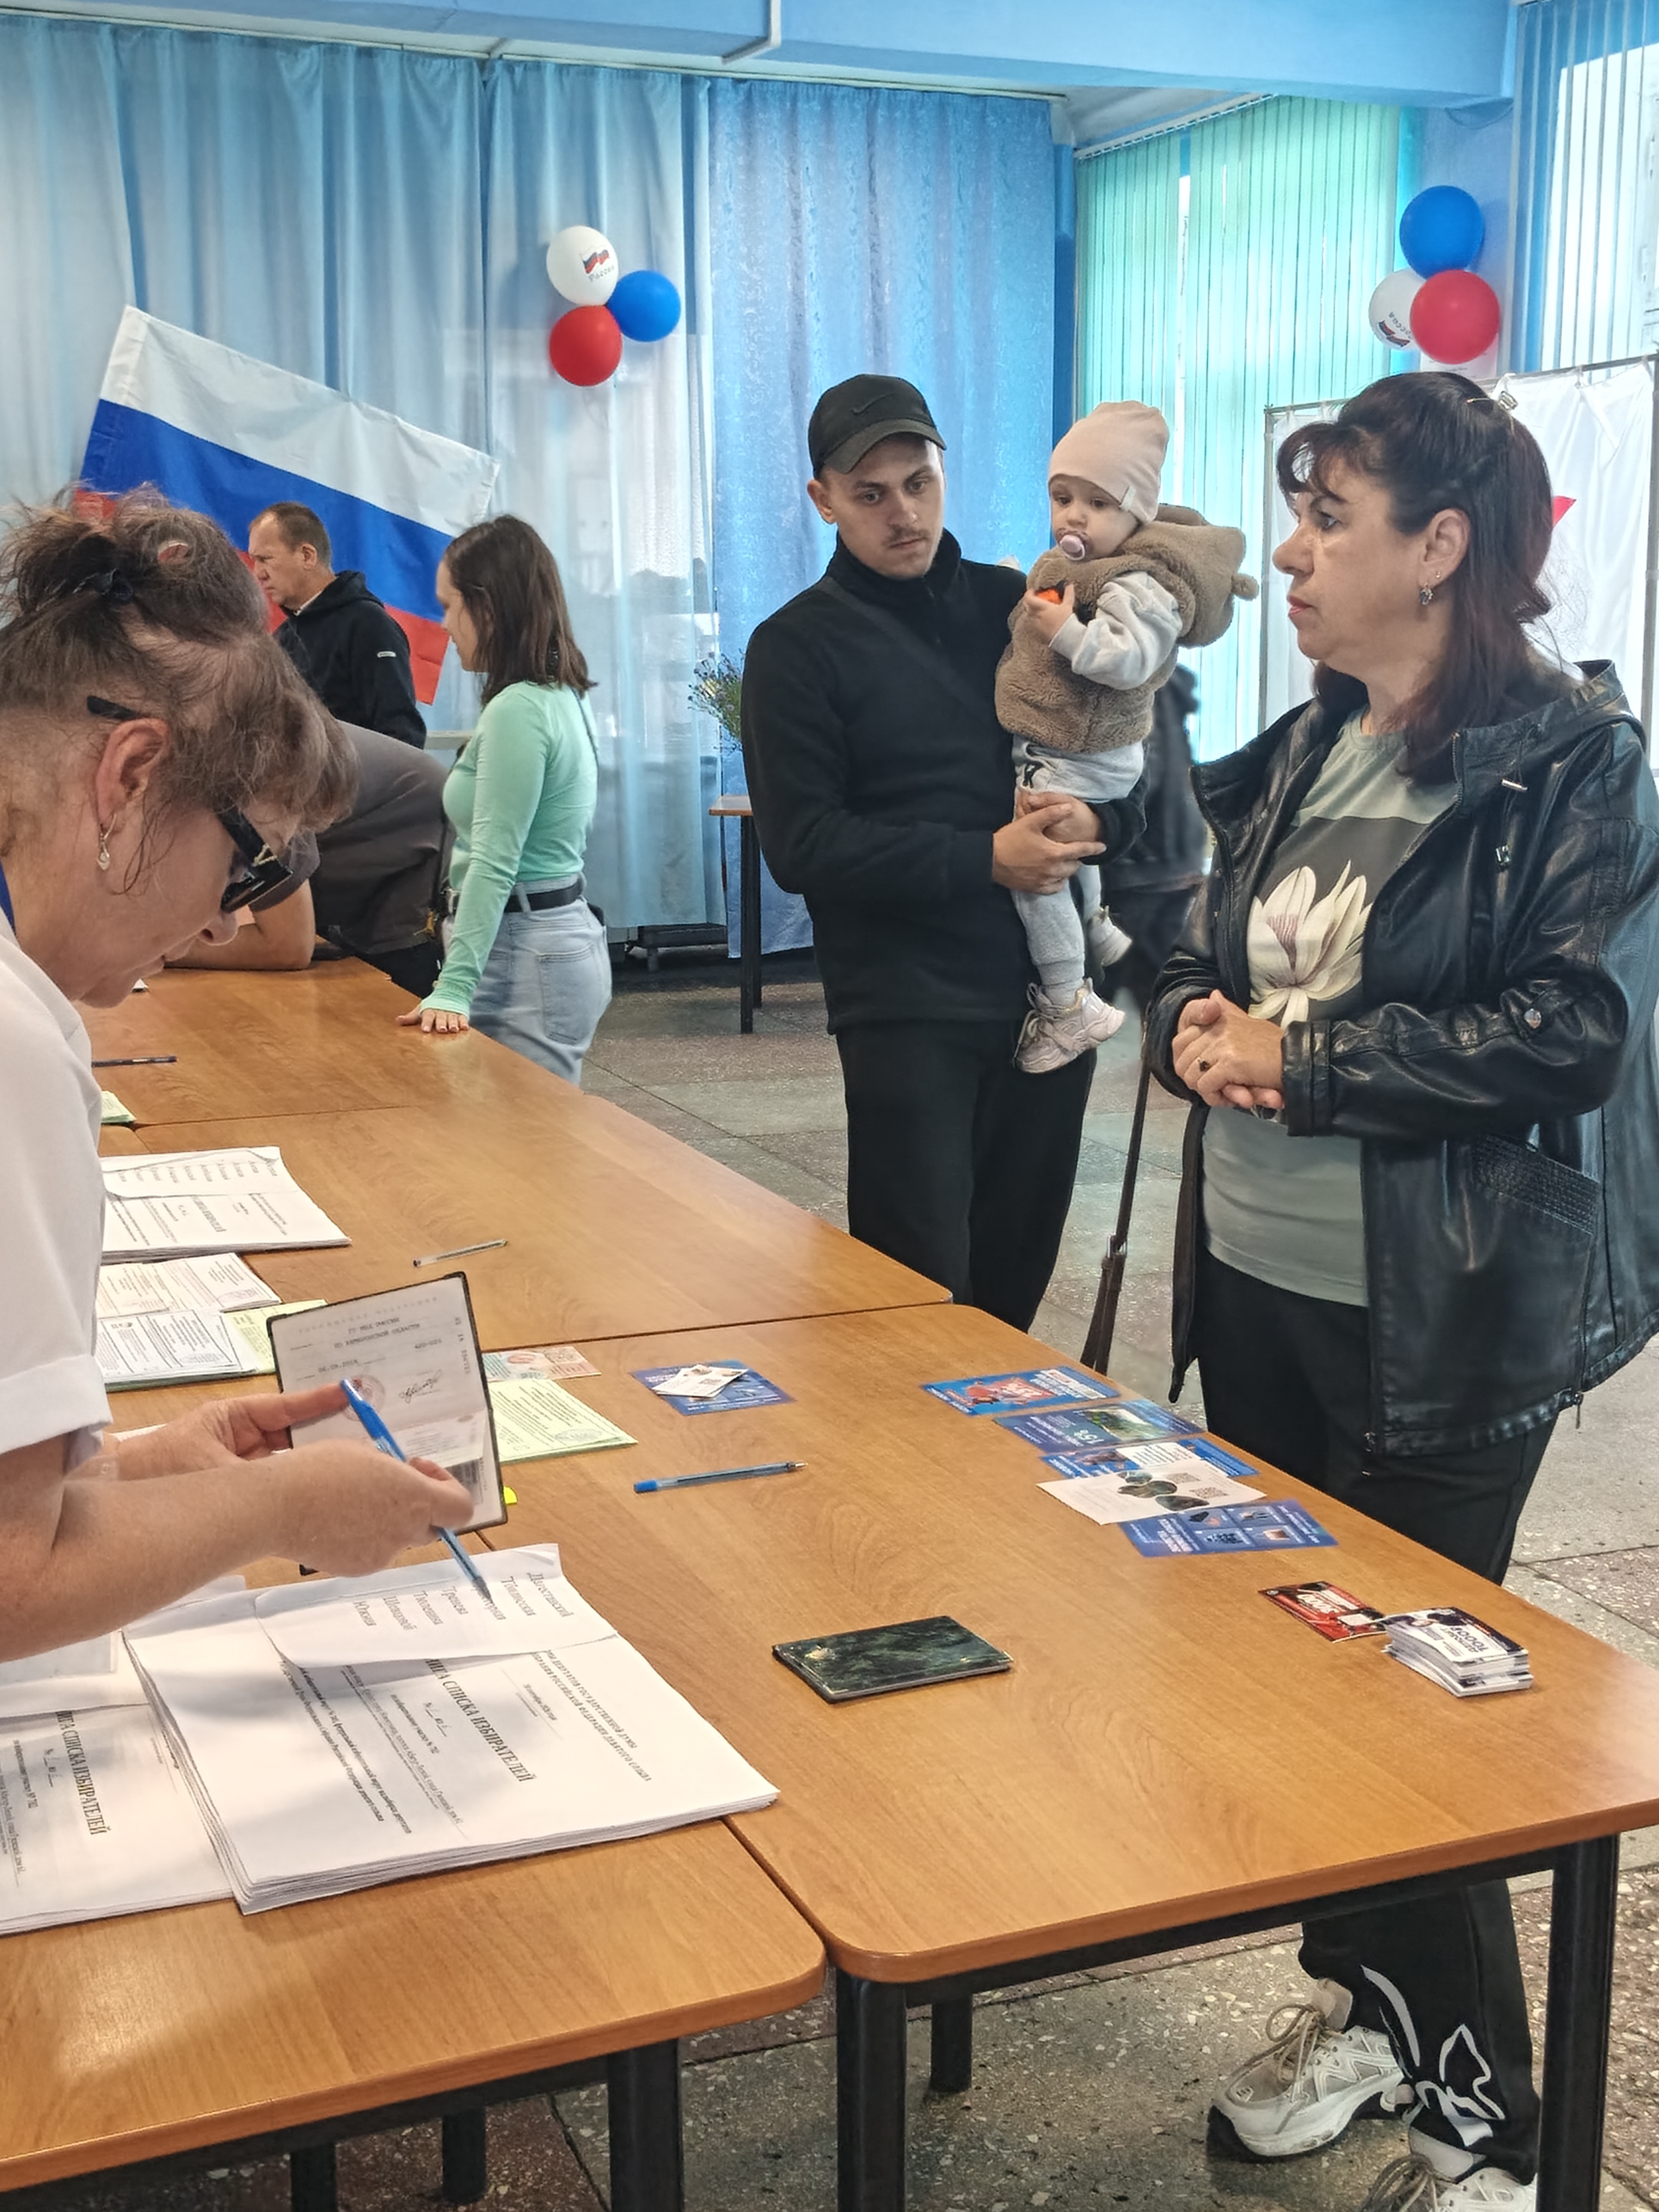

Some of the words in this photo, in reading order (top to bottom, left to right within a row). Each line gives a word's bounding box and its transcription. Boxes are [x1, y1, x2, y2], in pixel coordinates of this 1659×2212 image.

[62, 1730, 86, 1766] СПИСКА
[443, 1680, 480, 1716] СПИСКА
[470, 1716, 537, 1782] ИЗБИРАТЕЛЕЙ
[72, 1767, 112, 1835] ИЗБИРАТЕЛЕЙ
